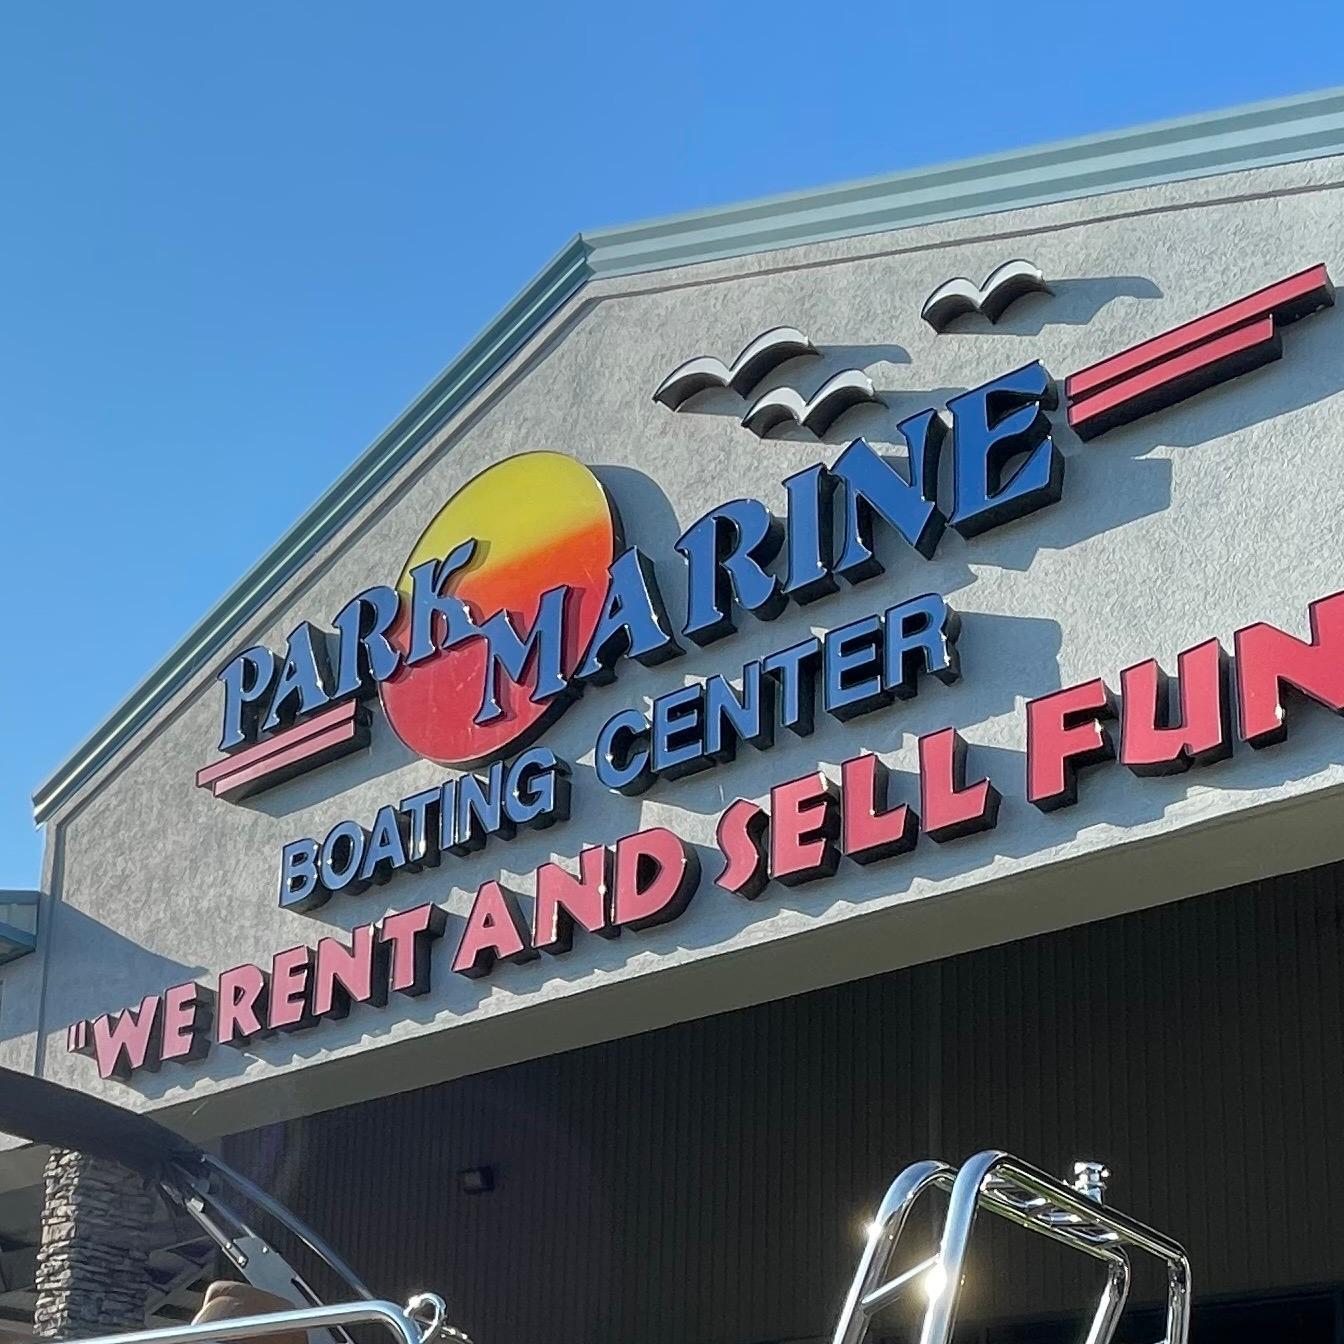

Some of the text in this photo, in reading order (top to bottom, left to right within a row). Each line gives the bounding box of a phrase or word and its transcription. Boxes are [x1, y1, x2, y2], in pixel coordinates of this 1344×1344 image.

[217, 538, 480, 753] PARK
[473, 359, 1061, 728] MARINE
[218, 903, 442, 1045] RENT
[454, 827, 694, 978] AND
[714, 727, 996, 898] SELL
[278, 594, 958, 909] BOATING CENTER
